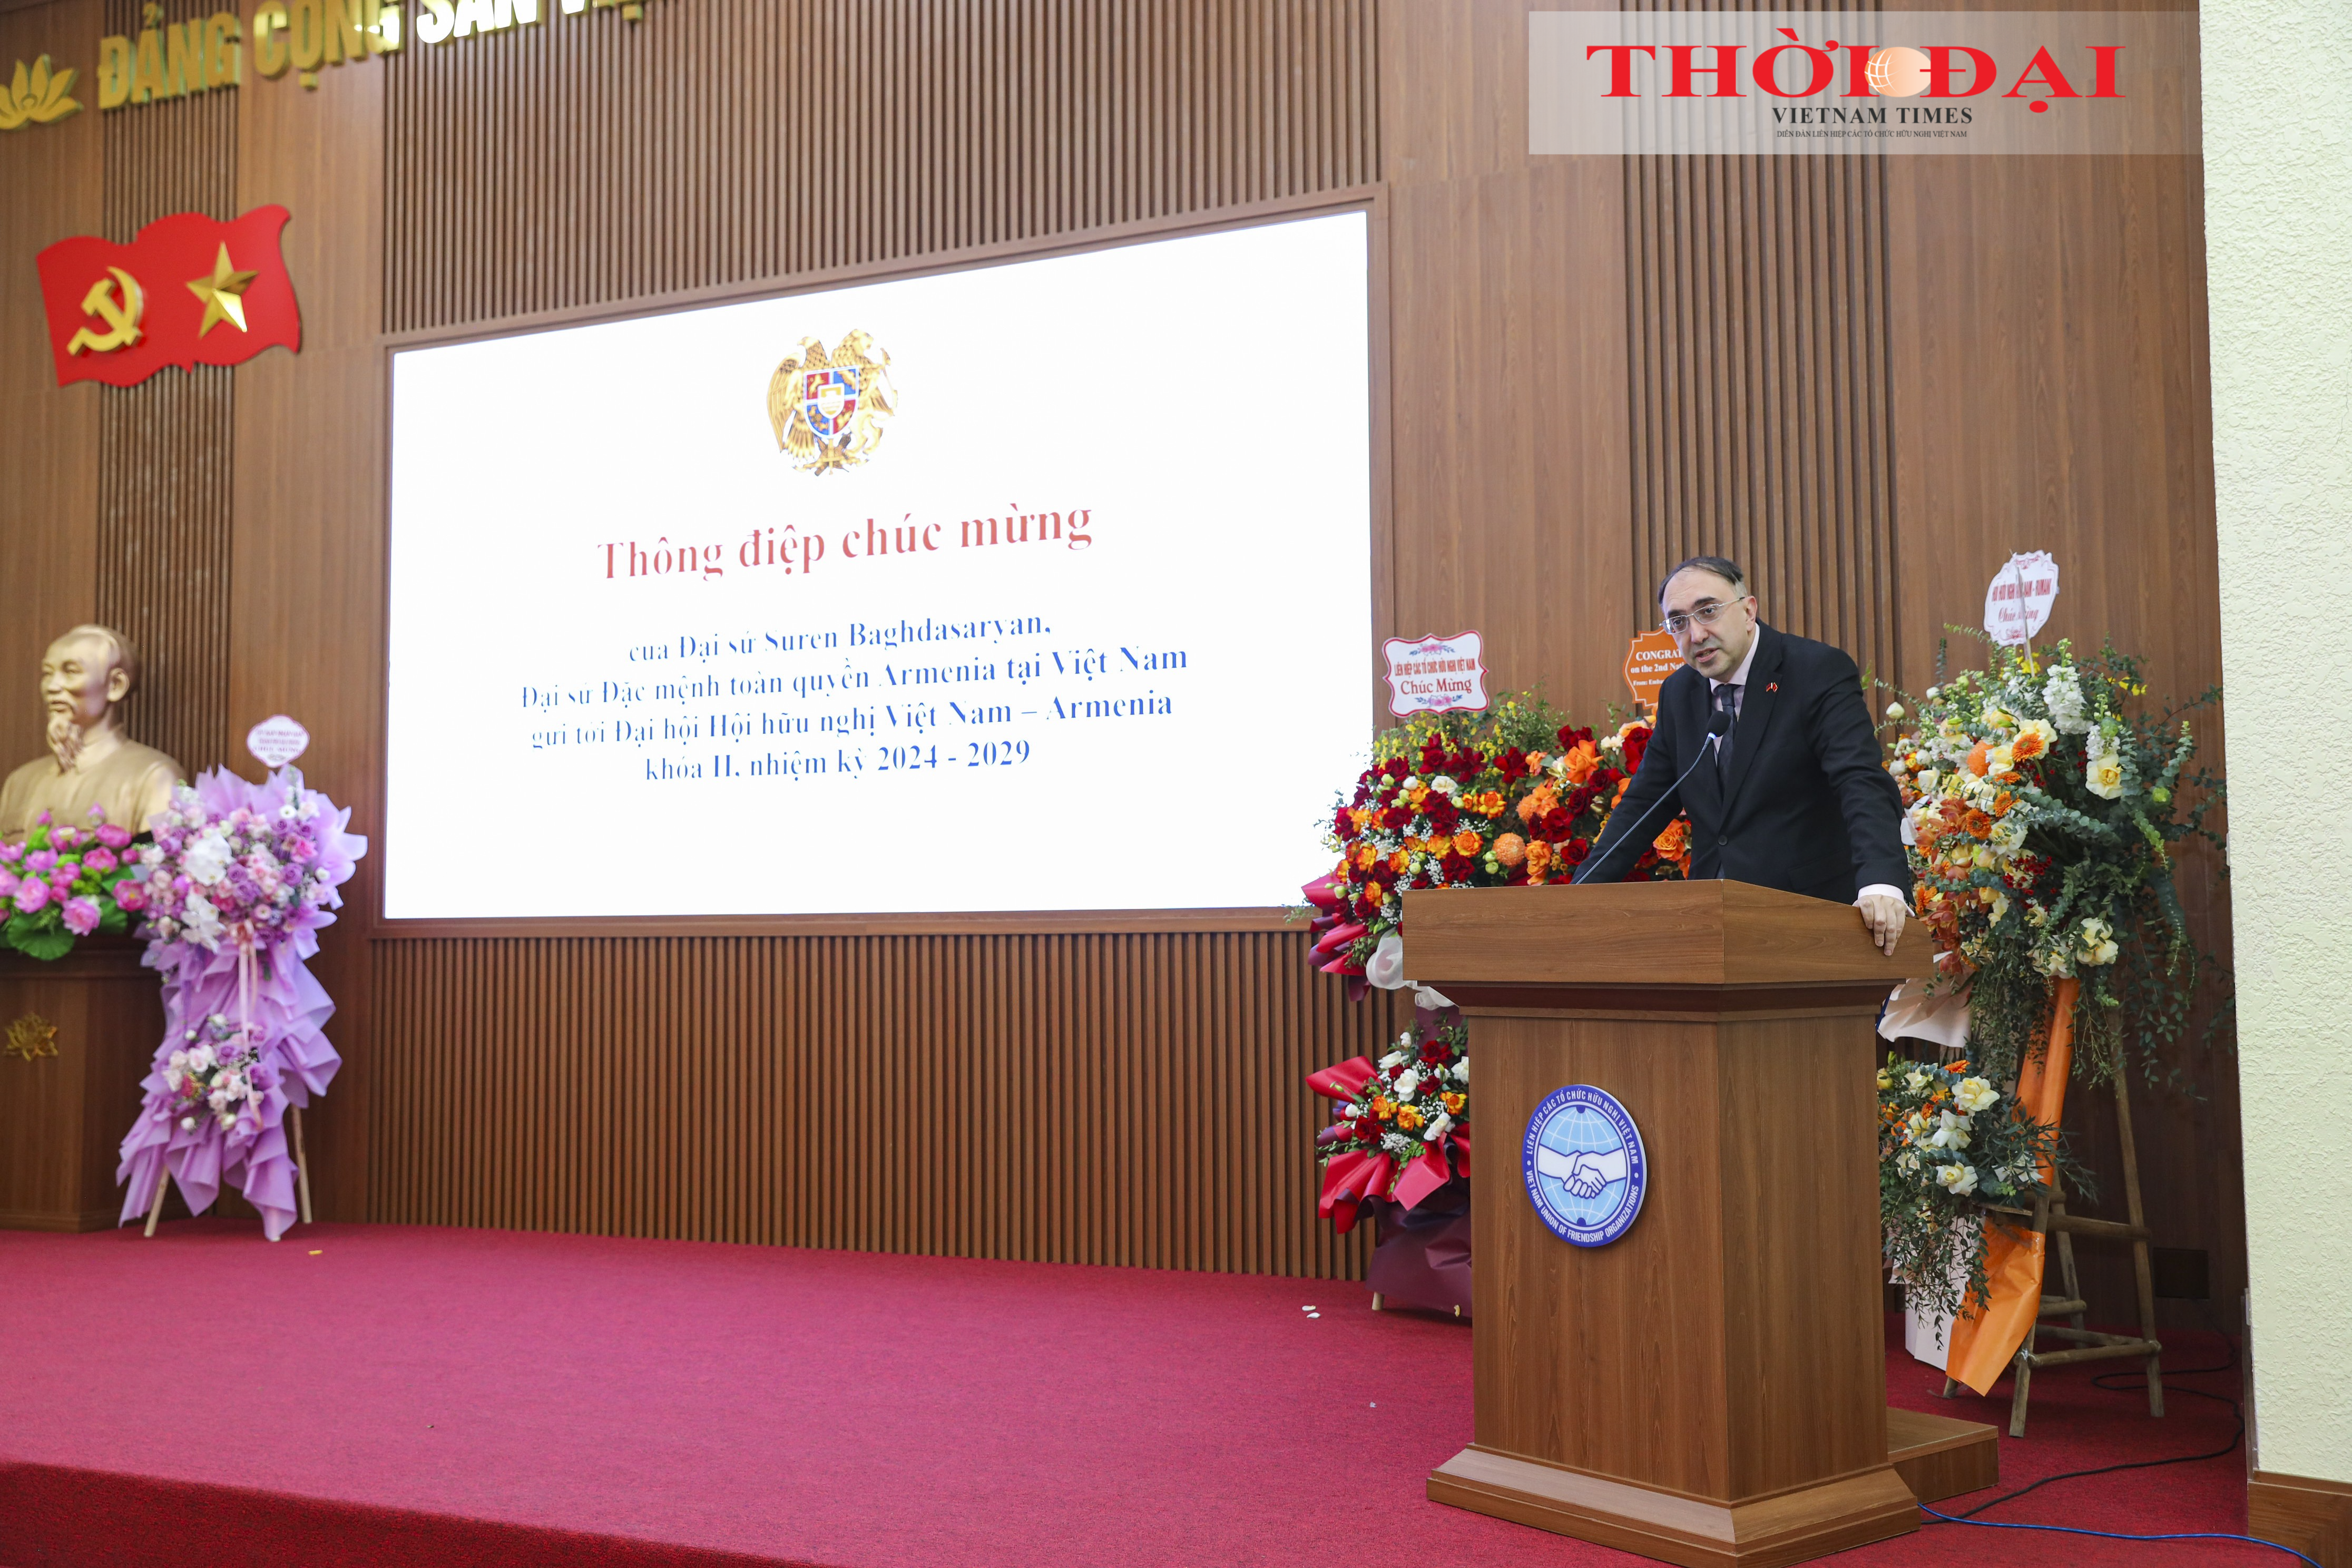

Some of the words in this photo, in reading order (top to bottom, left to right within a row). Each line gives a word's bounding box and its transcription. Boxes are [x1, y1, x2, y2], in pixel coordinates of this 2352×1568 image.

[97, 2, 241, 109] ĐẢNG
[597, 537, 723, 581] Thông
[739, 524, 825, 575] điệp
[842, 513, 941, 558] chúc
[961, 503, 1092, 550] mừng
[680, 633, 718, 663] Đại
[766, 630, 837, 651] Suren
[1641, 664, 1653, 673] the
[1654, 663, 1668, 672] 2nd
[523, 685, 557, 713] Đại
[603, 681, 644, 708] Đặc
[656, 674, 719, 705] mệnh
[731, 671, 781, 695] toàn
[793, 658, 868, 698] quyền
[879, 656, 995, 686] Armenia
[1007, 653, 1040, 685] tại
[1052, 649, 1108, 681] Việt
[1120, 646, 1187, 671] Nam
[1400, 680, 1433, 694] Chúc
[1436, 678, 1472, 694] Mừng
[616, 719, 653, 748] Đại
[665, 716, 698, 746] hội
[710, 713, 750, 743] Hội
[763, 712, 808, 734] hữu
[821, 706, 874, 738] nghị
[886, 702, 936, 734] Việt
[949, 701, 1011, 724] Nam
[1046, 690, 1172, 720] Armenia
[647, 756, 702, 780] khóa
[751, 751, 826, 781] nhiệm
[838, 748, 866, 779] kỳ
[878, 744, 937, 770] 2024
[967, 740, 1030, 767] 2029
[1526, 1133, 1535, 1154] LIÊN
[1531, 1112, 1544, 1133] HIỆP
[1542, 1101, 1556, 1114] CÁC
[1556, 1090, 1565, 1104] TỔ
[1566, 1088, 1586, 1100] CHỨC
[1587, 1092, 1603, 1105] HỮU
[1603, 1101, 1621, 1123] NGHỊ
[1618, 1119, 1632, 1140] VIỆT
[1628, 1141, 1639, 1164] NAM
[1526, 1170, 1536, 1188] VIET
[1531, 1188, 1543, 1209] NAM
[1541, 1206, 1559, 1230] UNION
[1558, 1224, 1567, 1235] OF
[1567, 1229, 1604, 1242] FRIENDSHIP
[1604, 1184, 1639, 1237] ORGANIZATIONS
